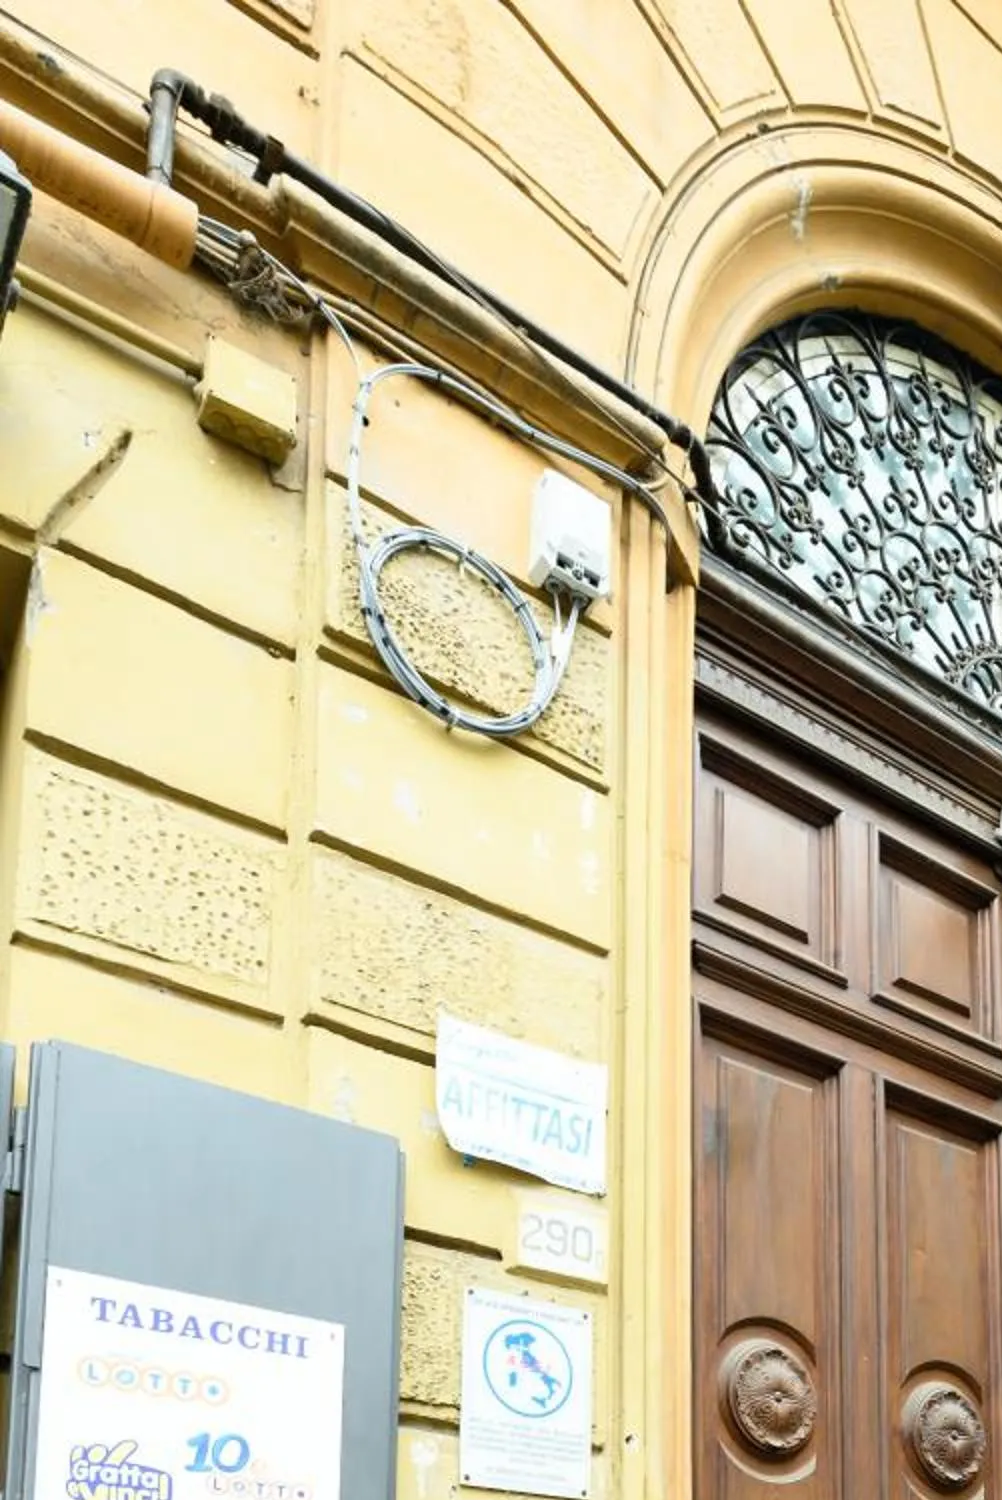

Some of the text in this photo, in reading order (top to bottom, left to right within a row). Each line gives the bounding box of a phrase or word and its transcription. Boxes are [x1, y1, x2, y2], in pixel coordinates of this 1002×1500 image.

[521, 1213, 593, 1264] 290
[91, 1296, 310, 1360] TABACCHI
[72, 1459, 160, 1489] Gratta
[185, 1432, 250, 1474] 10
